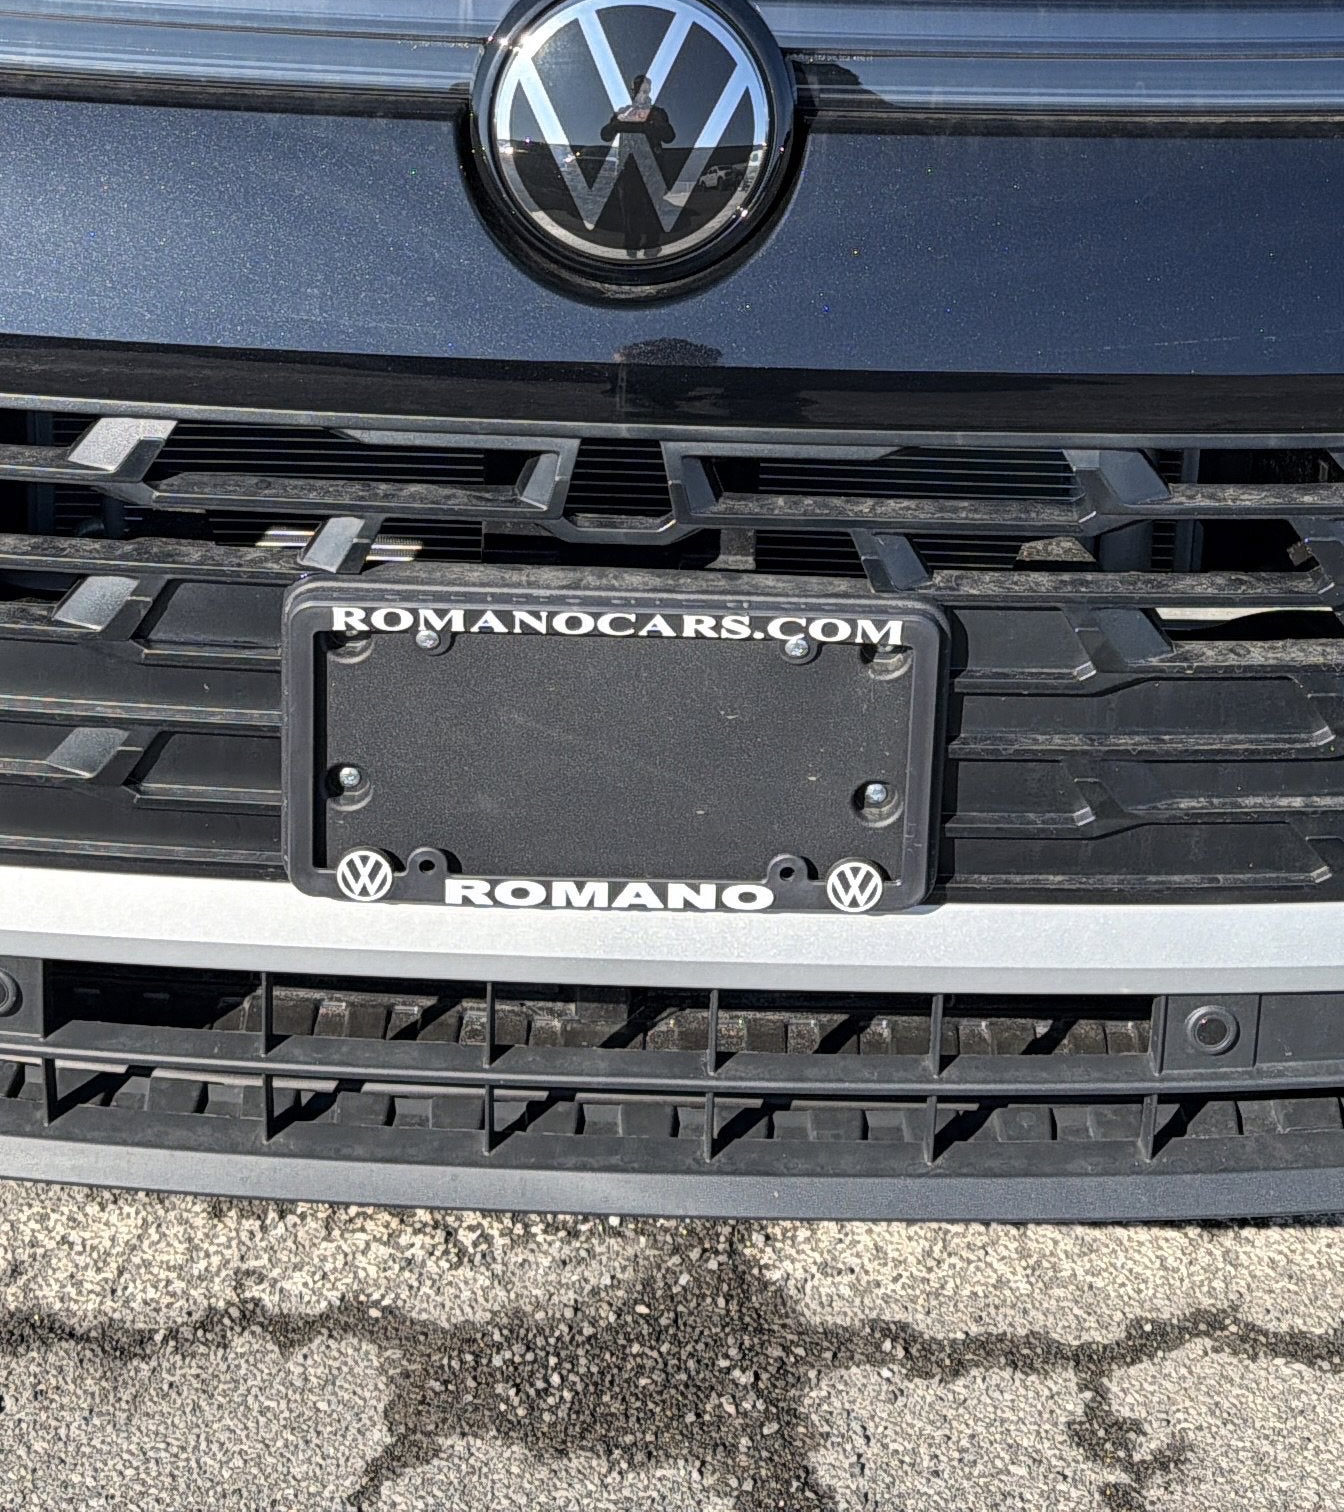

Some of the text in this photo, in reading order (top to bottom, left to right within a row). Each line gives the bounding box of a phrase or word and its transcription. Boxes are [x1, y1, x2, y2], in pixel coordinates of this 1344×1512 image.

[330, 605, 903, 645] ROMANOCARS.COM
[336, 849, 394, 903] VW
[444, 877, 774, 910] ROMANO
[826, 860, 884, 913] VW
